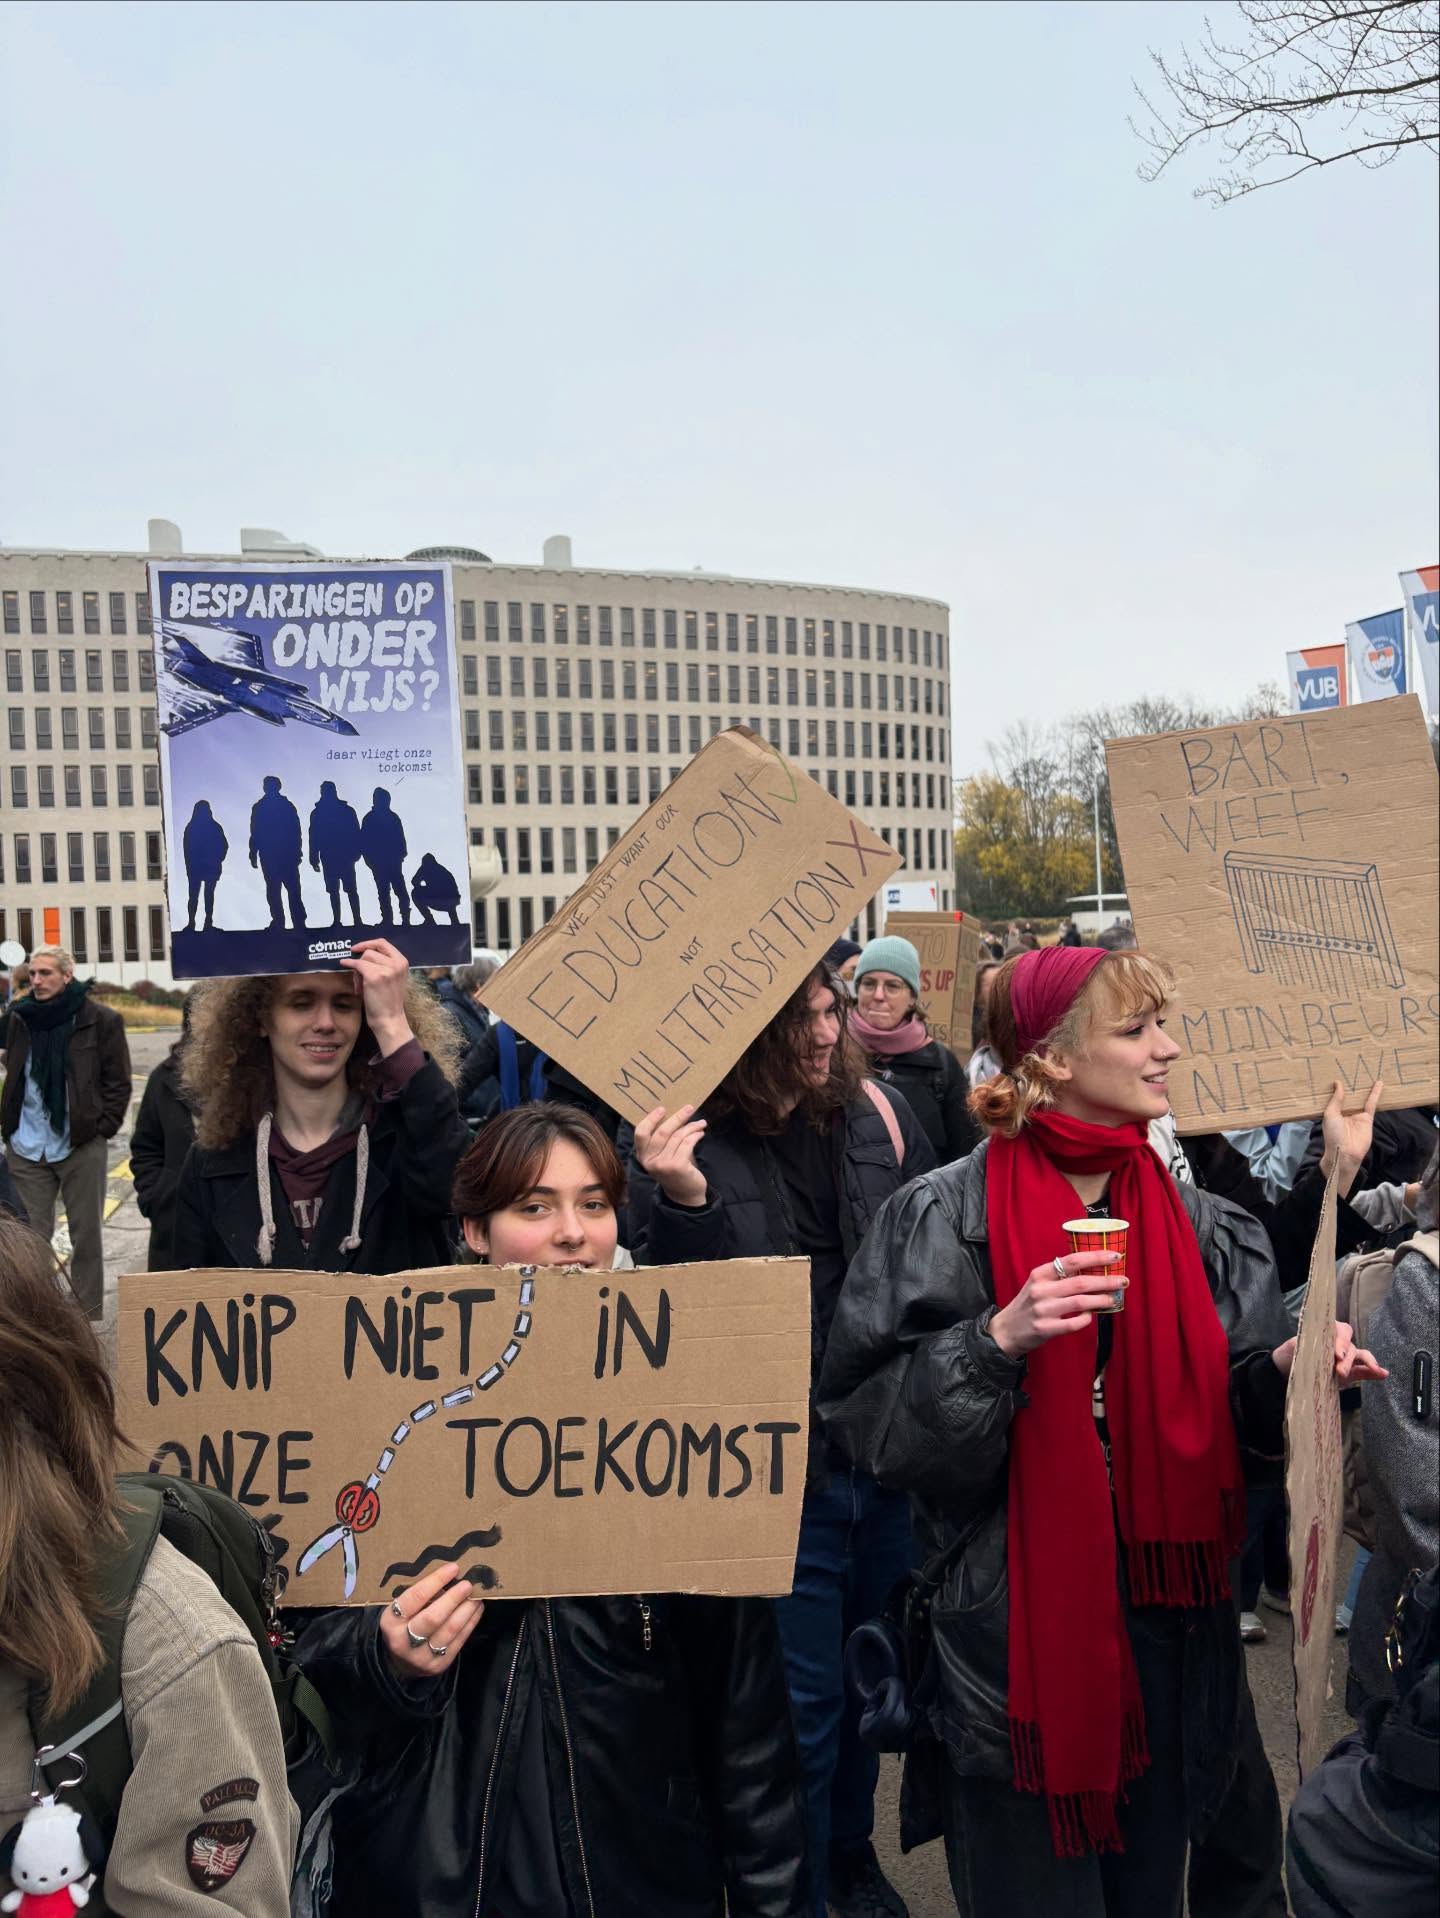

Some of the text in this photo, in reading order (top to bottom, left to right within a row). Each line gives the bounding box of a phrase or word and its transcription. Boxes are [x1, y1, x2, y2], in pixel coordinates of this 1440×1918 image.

[169, 581, 434, 619] BESPARINGEN OP
[272, 620, 438, 669] ONDER
[319, 669, 440, 713] WIJS?
[1296, 675, 1338, 702] VUB
[361, 748, 400, 761] vliegt
[403, 749, 432, 758] onze
[378, 761, 433, 773] toekomst
[1180, 718, 1350, 798] BART,
[1160, 787, 1329, 854] WEEF
[560, 803, 680, 938] WE JUST WANT OUR
[526, 772, 782, 1040] EDUCATION
[308, 939, 352, 953] comac
[679, 934, 705, 967] NOT
[613, 861, 855, 1114] MILITARISATION
[935, 969, 955, 992] UP
[1182, 1003, 1298, 1055] MIJN
[1192, 1054, 1321, 1115] NIET
[445, 1415, 801, 1500] TOEKOMST
